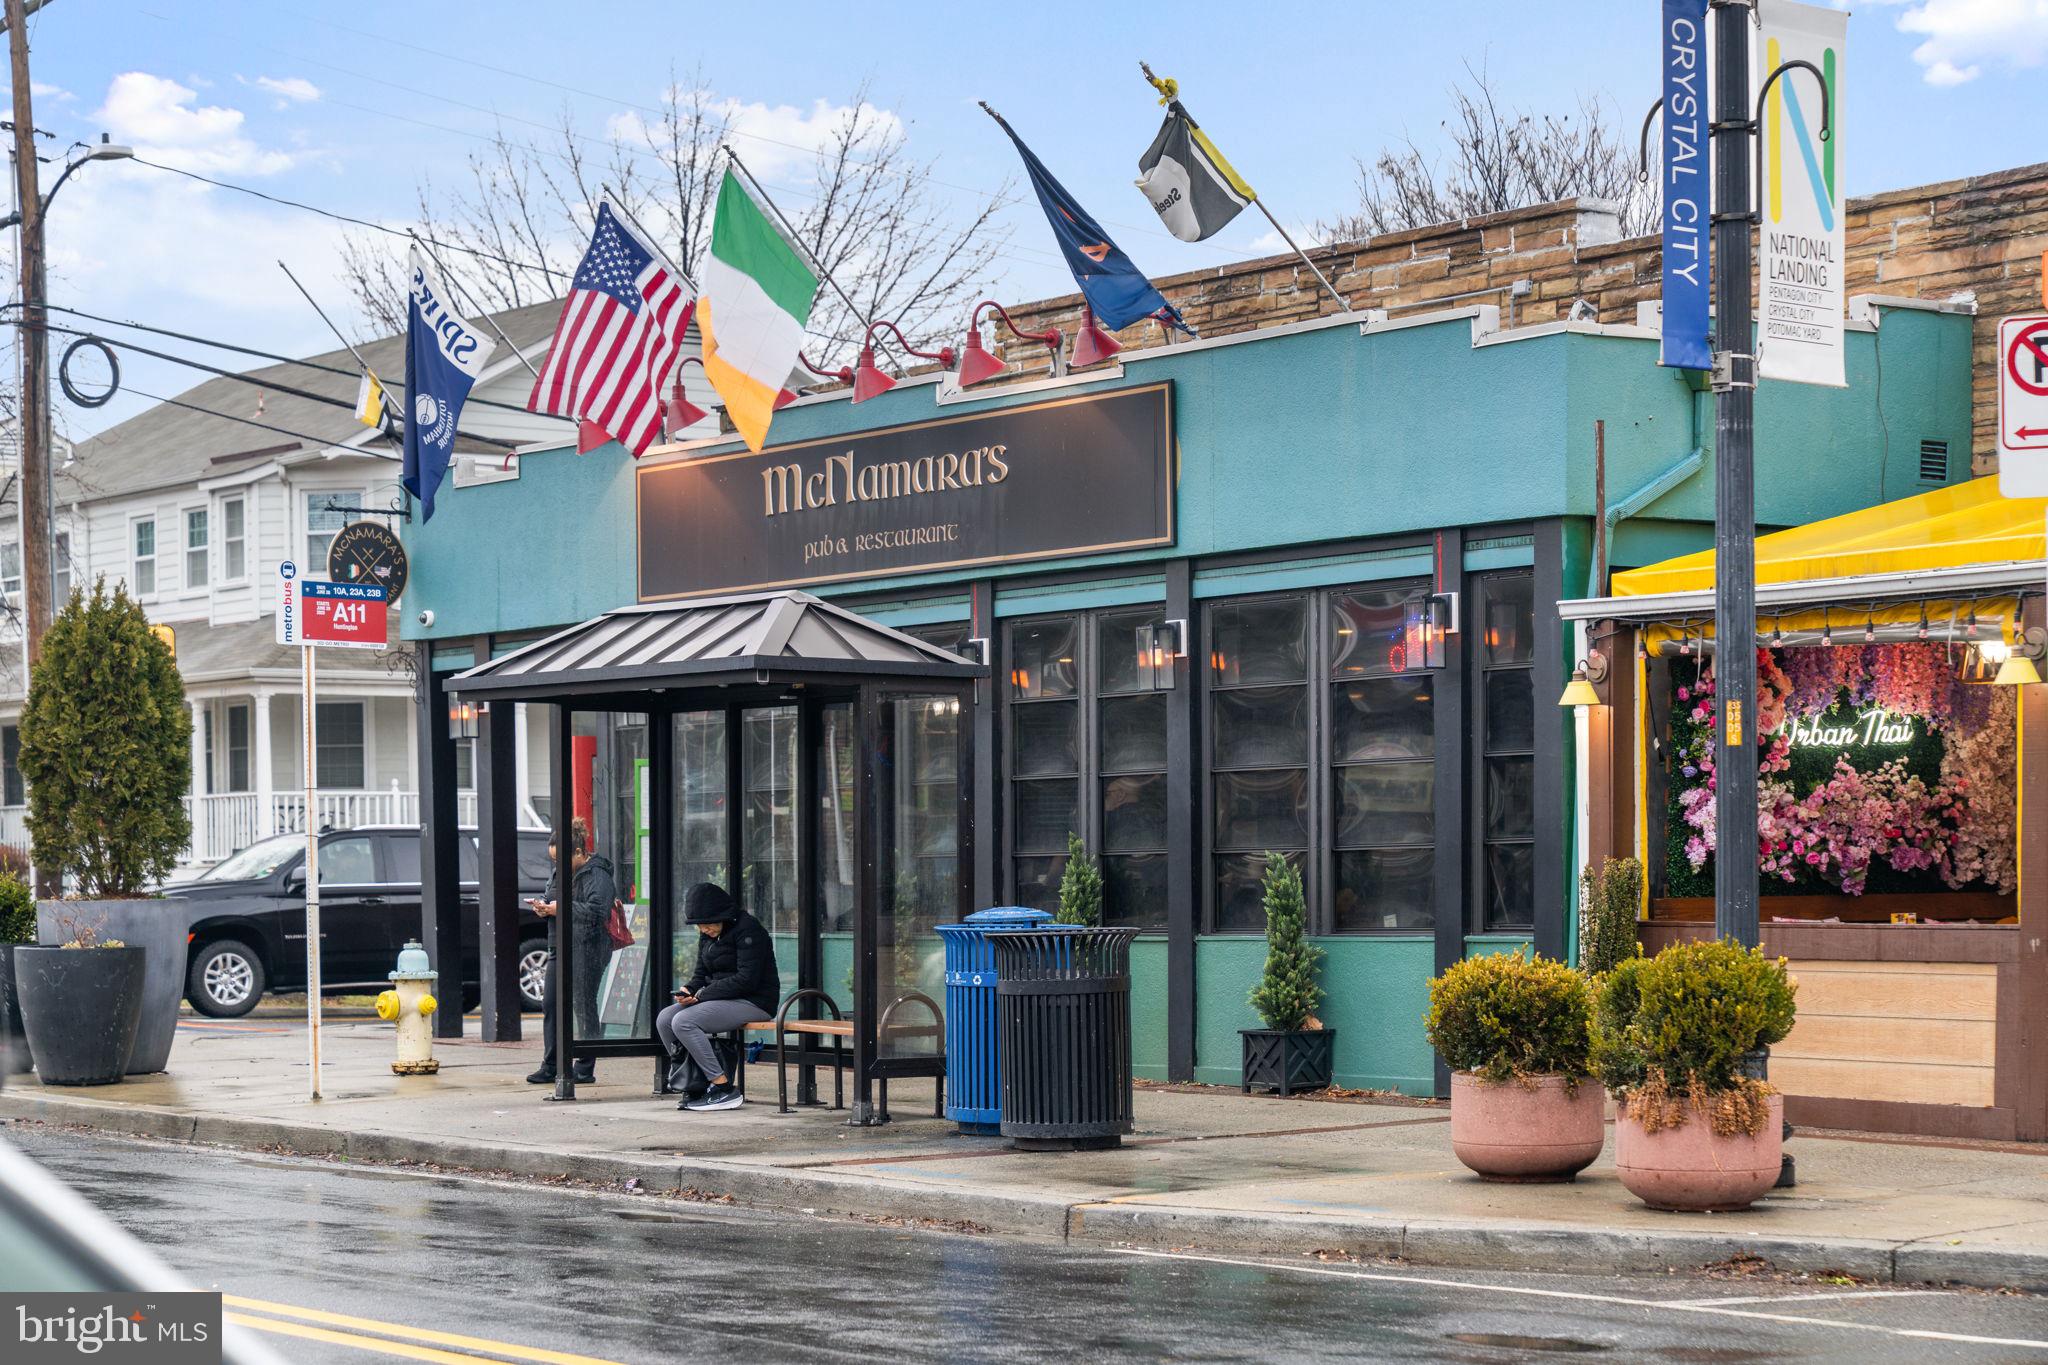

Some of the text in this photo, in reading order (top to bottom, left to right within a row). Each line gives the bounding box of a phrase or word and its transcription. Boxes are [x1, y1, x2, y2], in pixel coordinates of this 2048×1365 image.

[1671, 18, 1698, 287] CRYSTAL CITY
[1770, 232, 1834, 263] NATIONAL
[1770, 258, 1827, 287] LANDING
[1769, 286, 1822, 303] PENTAGON CITY
[1768, 304, 1816, 321] CRYSTAL CITY
[1767, 322, 1822, 340] POTOMAC YARD
[836, 537, 849, 555] &
[349, 588, 366, 598] 23A,
[366, 589, 382, 598] 23B
[283, 581, 293, 642] metrobus
[332, 602, 366, 624] A11
[1860, 709, 1915, 747] Thai
